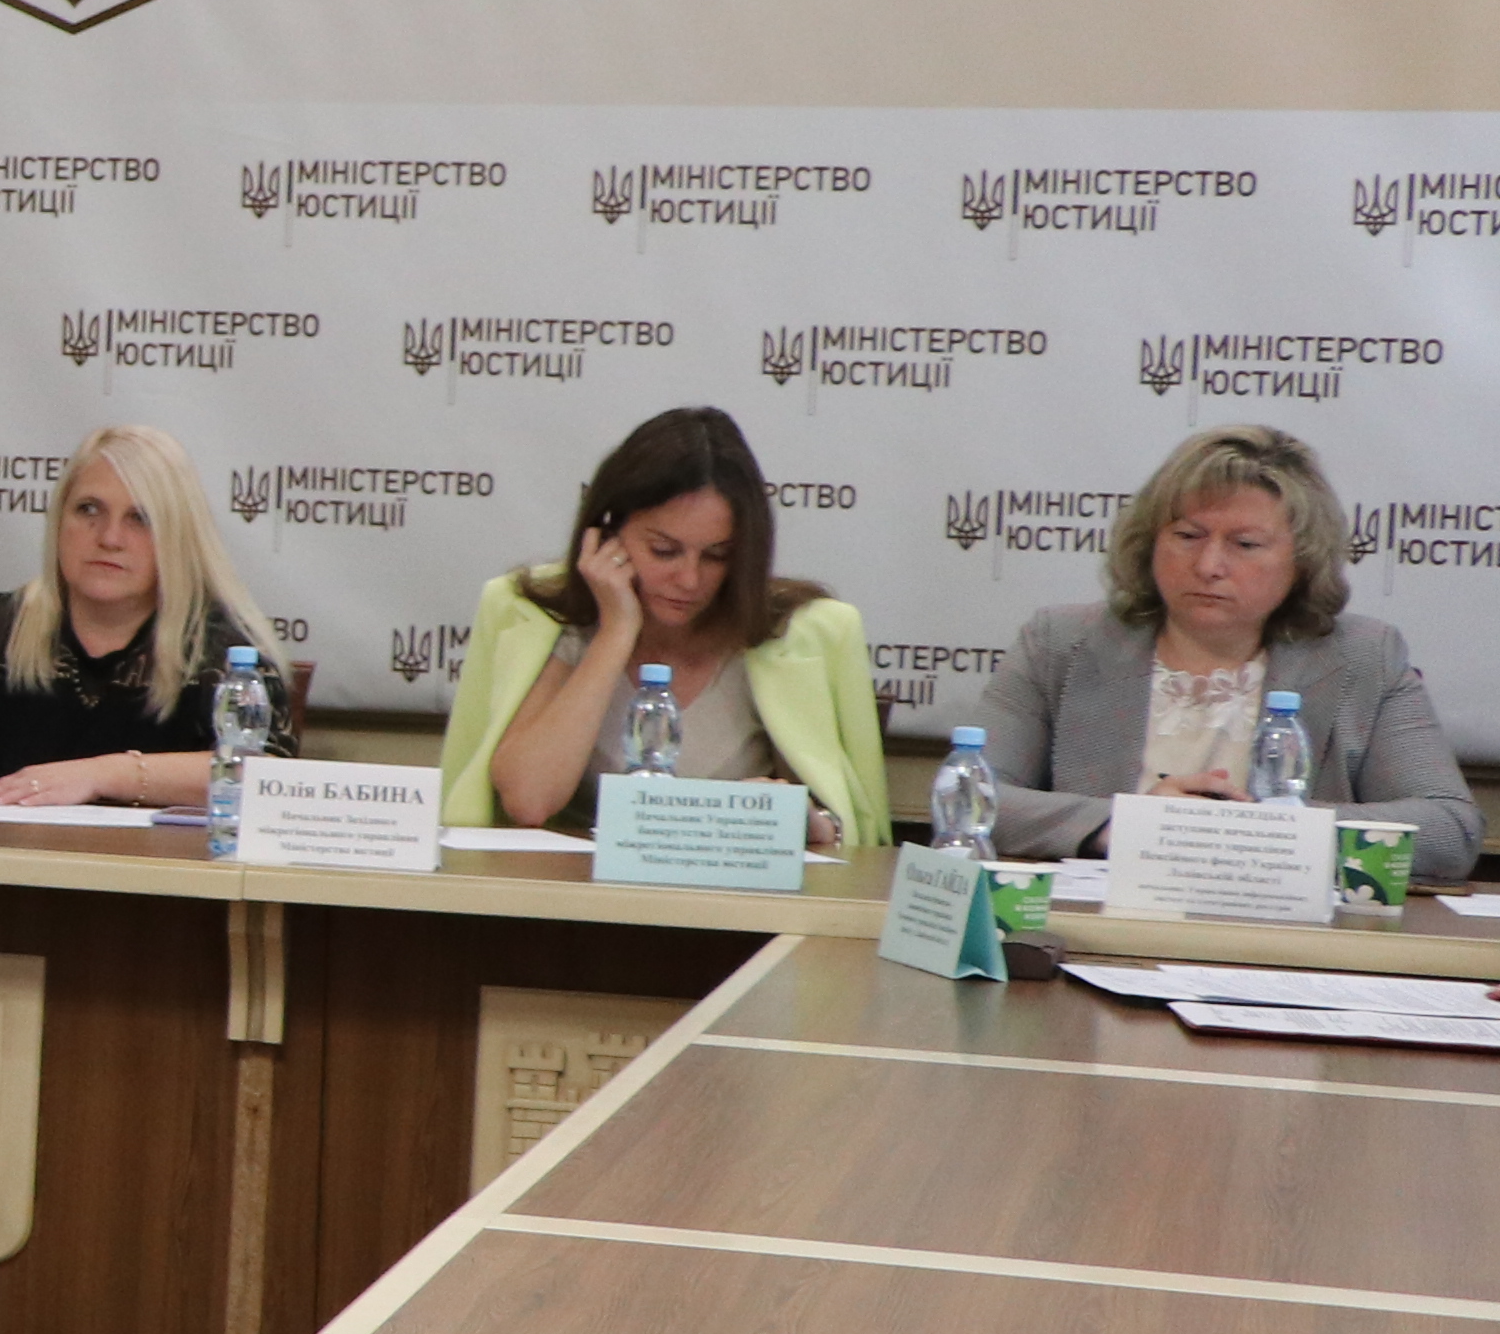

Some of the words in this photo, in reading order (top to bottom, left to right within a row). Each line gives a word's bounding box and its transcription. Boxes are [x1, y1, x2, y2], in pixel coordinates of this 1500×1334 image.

[296, 160, 507, 188] МІНІСТЕРСТВО
[650, 164, 872, 193] МІНІСТЕРСТВО
[1022, 169, 1258, 199] МІНІСТЕРСТВО
[296, 187, 418, 221] ЮСТИЦІЇ
[649, 191, 778, 227] ЮСТИЦІЇ
[1022, 197, 1159, 233] ЮСТИЦІЇ
[115, 309, 321, 340] МІНІСТЕРСТВО
[460, 316, 675, 347] МІНІСТЕРСТВО
[115, 336, 235, 370] ЮСТИЦІЇ
[821, 325, 1048, 358] МІНІСТЕРСТВО
[1204, 333, 1443, 366] МІНІСТЕРСТВО
[459, 344, 584, 380] ЮСТИЦІЇ
[820, 355, 952, 392] ЮСТИЦІЇ
[1202, 364, 1342, 403] ЮСТИЦІЇ
[287, 465, 495, 499] МІНІСТЕРСТВО
[286, 495, 407, 532] ЮСТИЦІЇ
[1398, 538, 1500, 567] ЮСТИ
[258, 779, 317, 799] Юлія
[323, 782, 426, 805] БАБИНА
[631, 790, 723, 809] Людмила
[728, 793, 774, 811] ГОЙ
